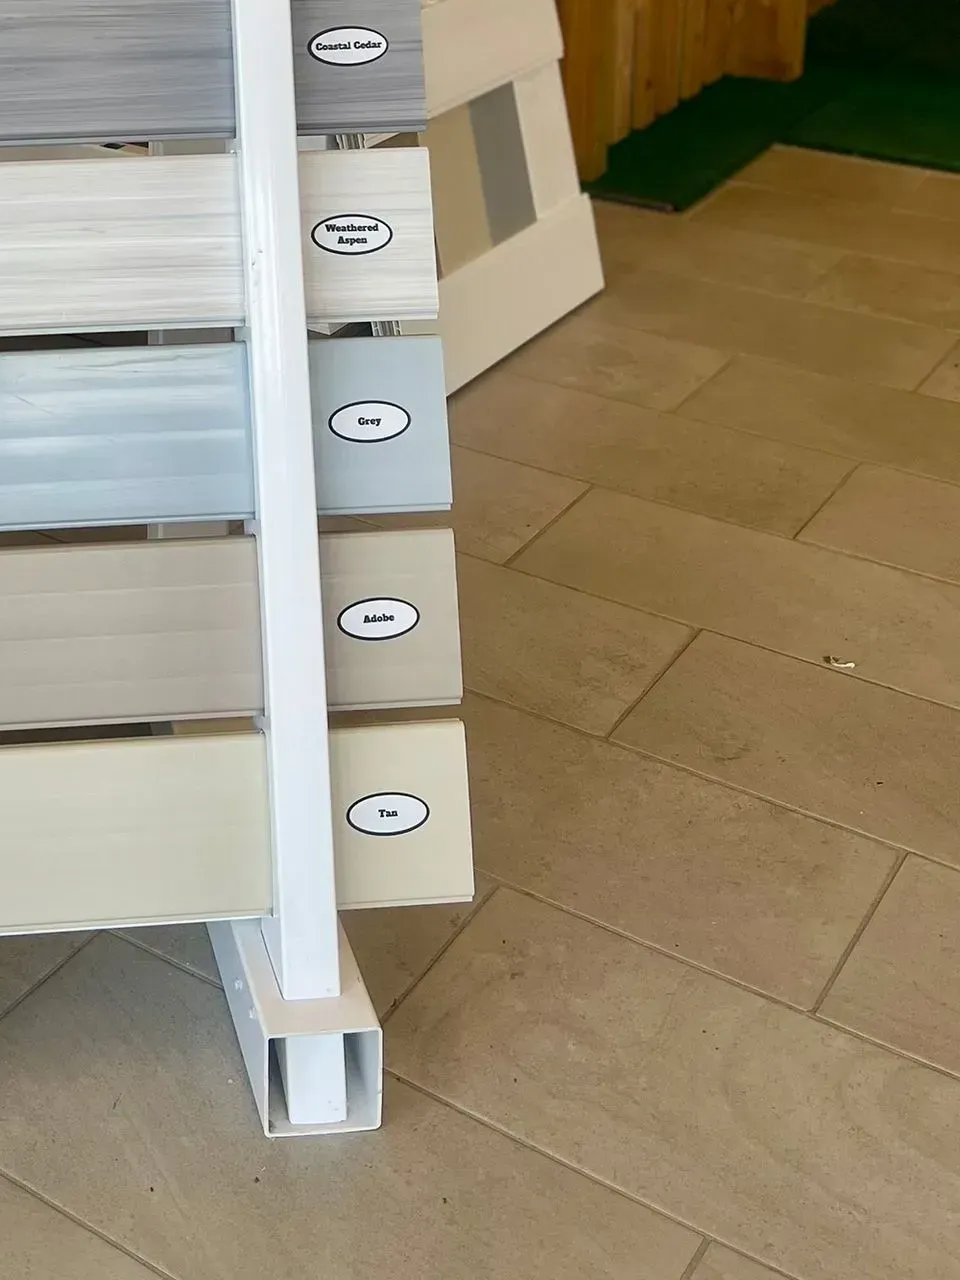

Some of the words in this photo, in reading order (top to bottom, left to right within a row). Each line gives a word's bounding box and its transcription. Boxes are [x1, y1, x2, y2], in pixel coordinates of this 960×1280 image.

[315, 41, 352, 51] Coastal
[353, 40, 383, 50] Cedar
[324, 223, 379, 233] Weathered
[337, 235, 368, 247] Aspen
[357, 416, 383, 427] Grey
[363, 613, 395, 624] Adobe
[377, 808, 399, 818] Tan
